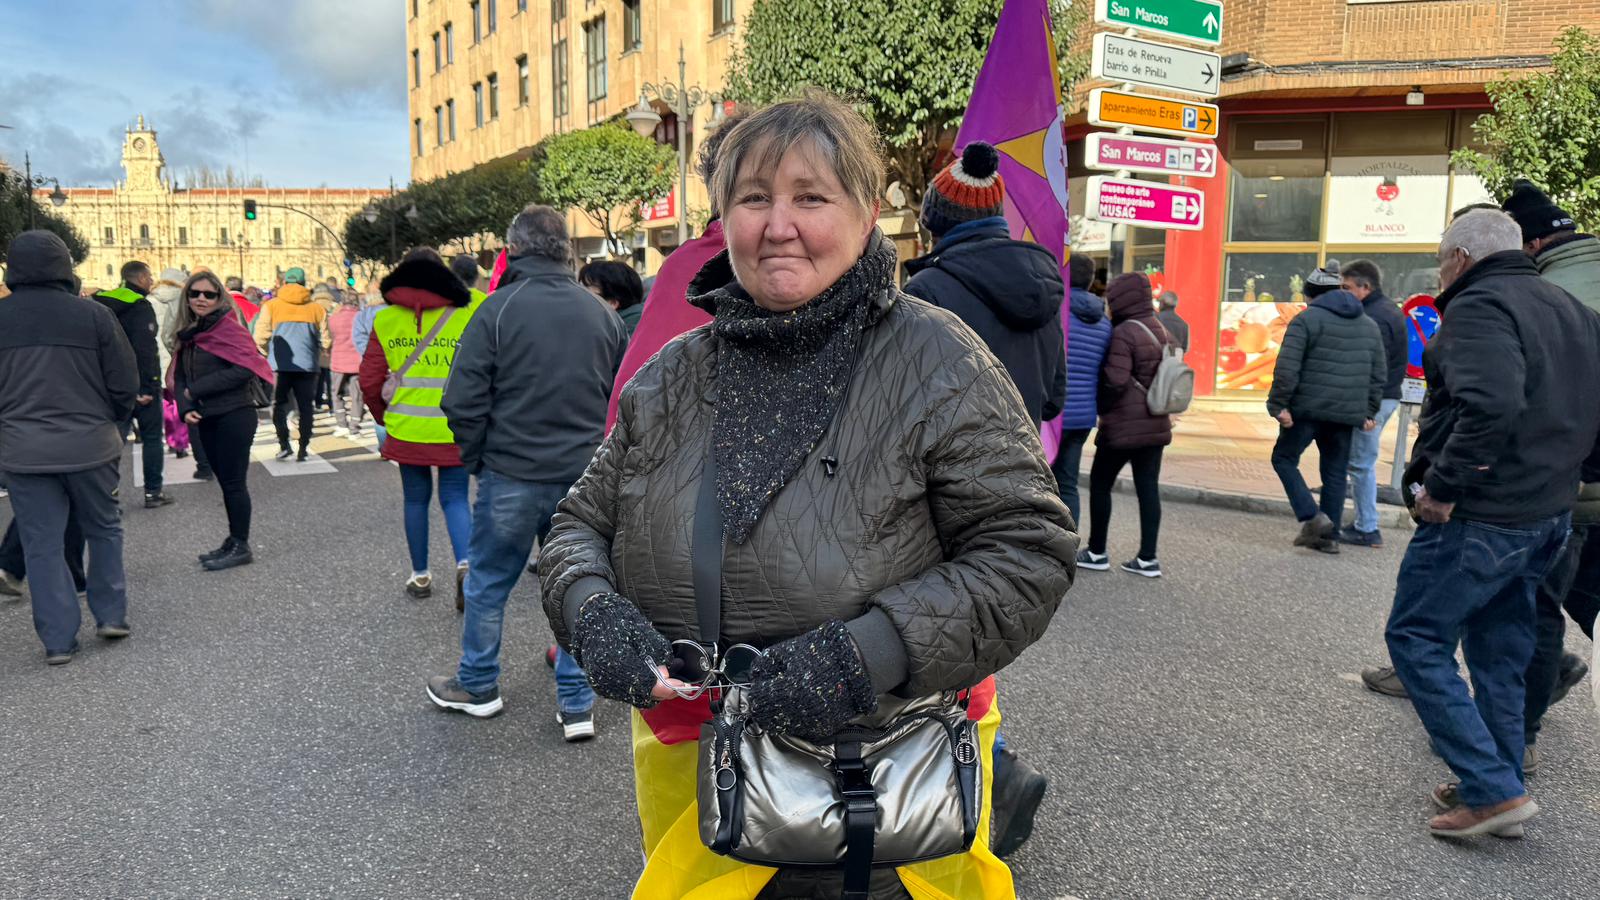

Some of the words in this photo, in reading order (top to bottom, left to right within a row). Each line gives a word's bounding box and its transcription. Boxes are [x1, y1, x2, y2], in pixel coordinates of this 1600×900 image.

[1111, 1, 1130, 17] San
[1135, 6, 1169, 26] Marcos
[1107, 43, 1124, 55] Eras
[1127, 48, 1138, 58] de
[1141, 50, 1172, 64] Renueva
[1106, 60, 1129, 72] barrio
[1132, 65, 1141, 75] de
[1145, 66, 1167, 79] Pinilla
[1103, 102, 1157, 117] aparcamiento
[1159, 106, 1181, 120] Eras
[1183, 107, 1196, 128] P
[1101, 143, 1121, 159] San
[1126, 146, 1161, 163] Marcos
[1358, 160, 1420, 176] HORTALIZAS
[1101, 184, 1125, 194] museo
[1125, 186, 1135, 196] de
[1135, 187, 1151, 197] arte
[1100, 204, 1136, 219] MUSAC
[1365, 224, 1405, 232] BLANCO
